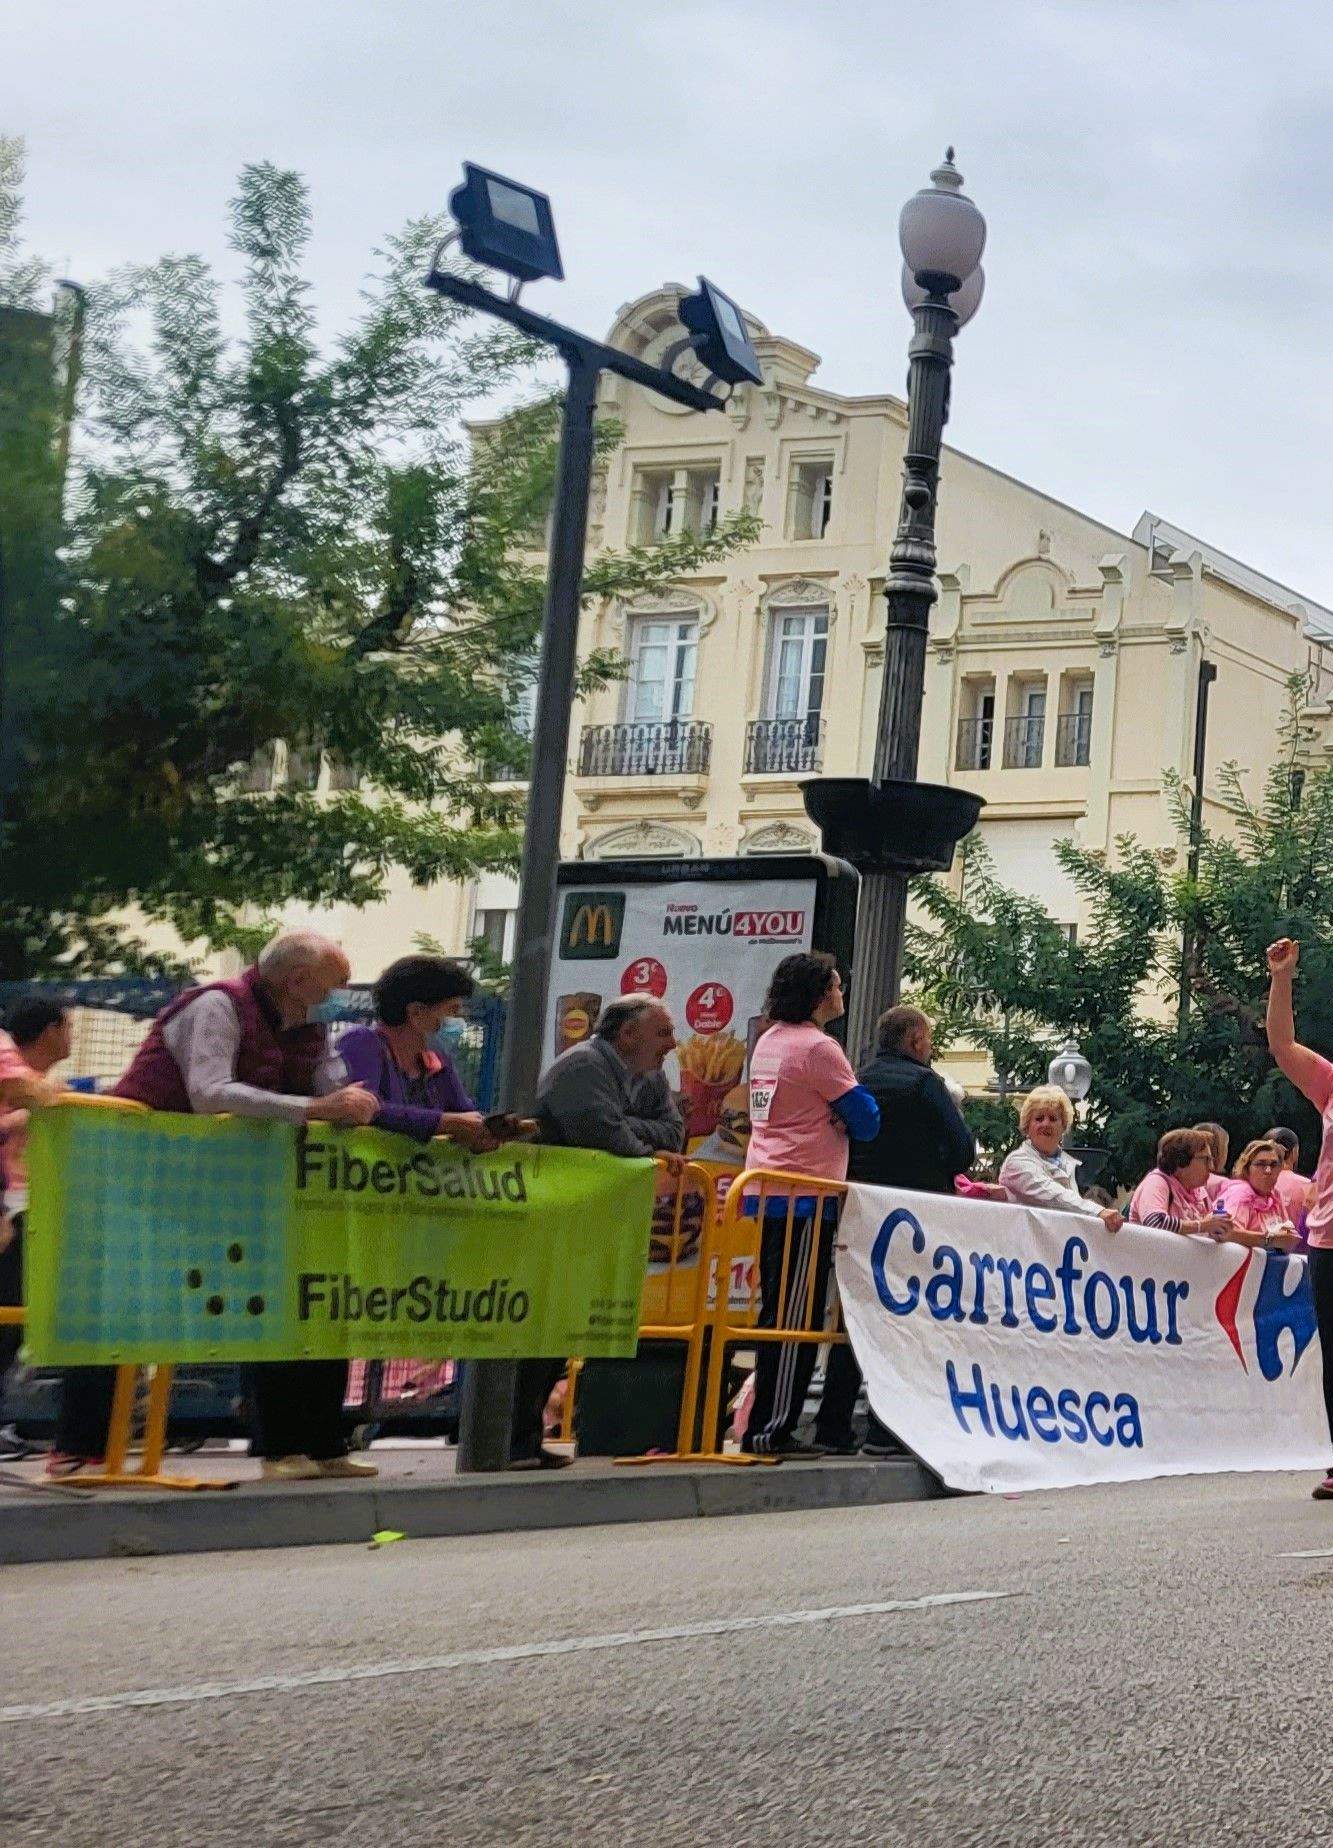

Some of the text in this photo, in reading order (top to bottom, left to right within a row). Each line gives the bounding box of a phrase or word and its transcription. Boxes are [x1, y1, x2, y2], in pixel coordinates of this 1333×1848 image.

[295, 1140, 527, 1203] FiberSalud
[298, 1272, 530, 1324] FiberStudio
[870, 1207, 1190, 1345] Carrefour
[945, 1359, 1144, 1449] Huesca
